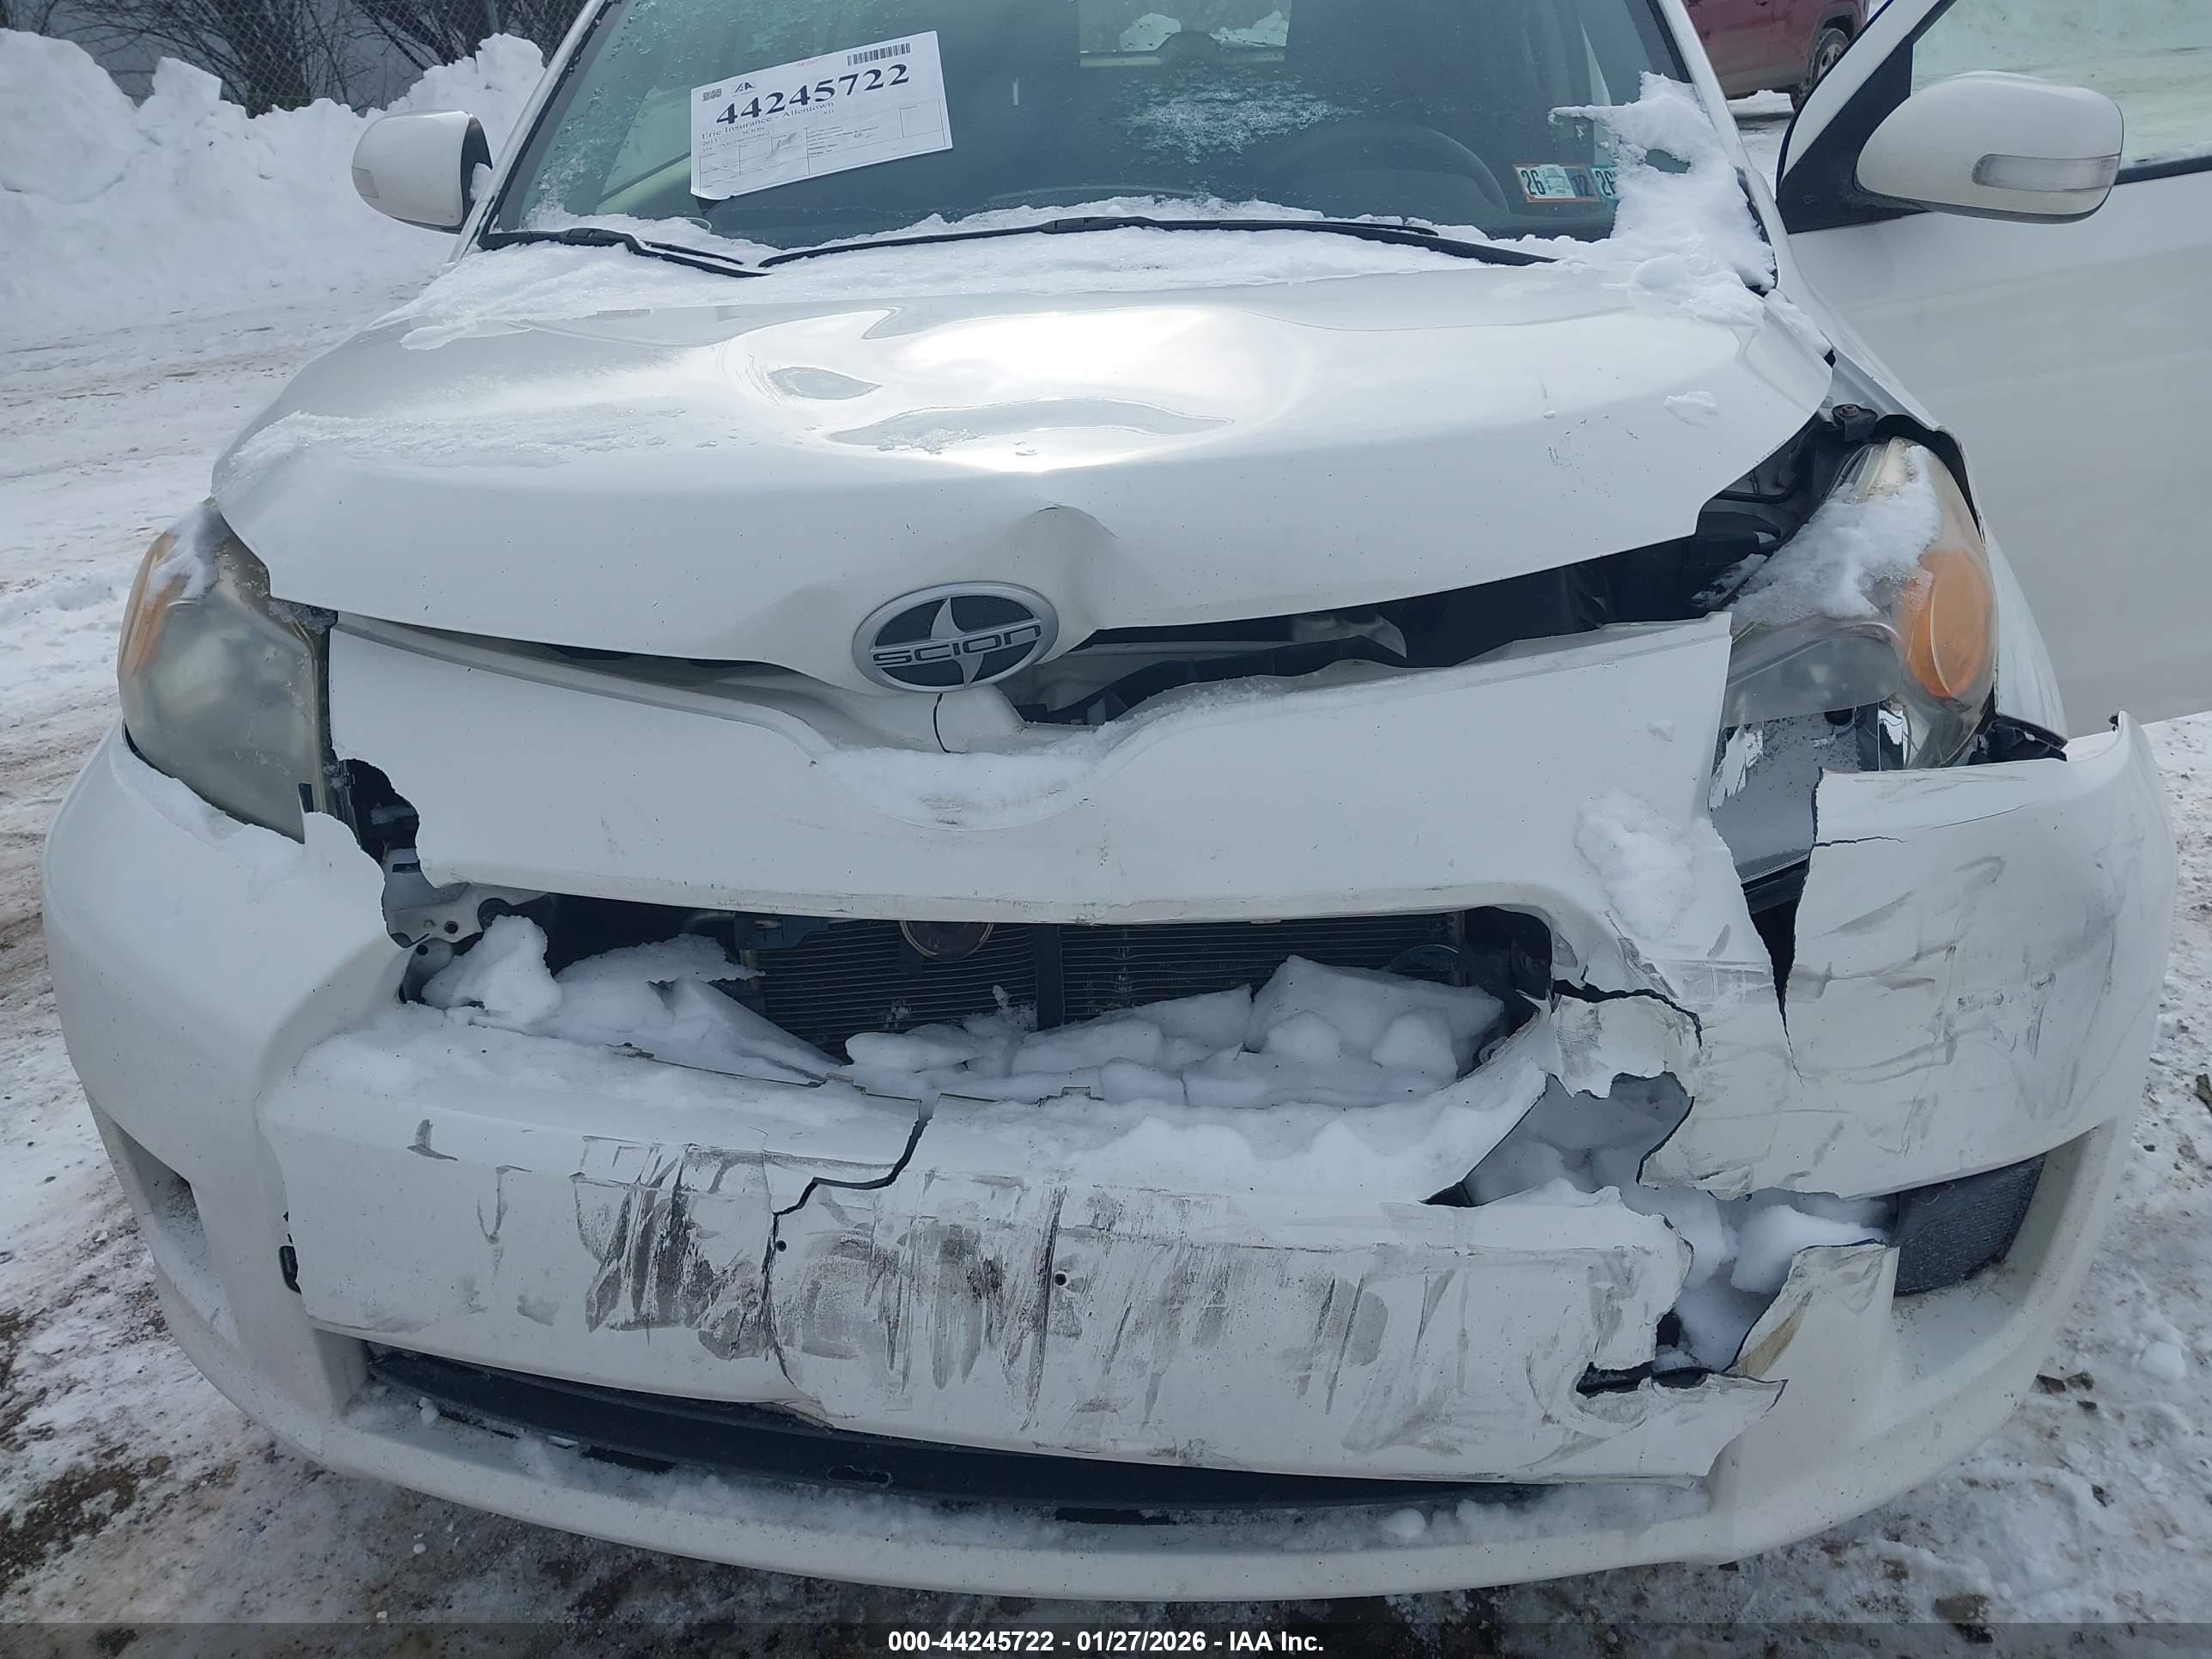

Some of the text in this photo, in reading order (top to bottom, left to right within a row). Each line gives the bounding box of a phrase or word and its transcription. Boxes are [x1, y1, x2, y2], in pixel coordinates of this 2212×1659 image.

[716, 64, 910, 125] 44245722
[724, 116, 773, 133] Insurance
[782, 101, 835, 118] Allentown
[1521, 169, 1547, 196] 26
